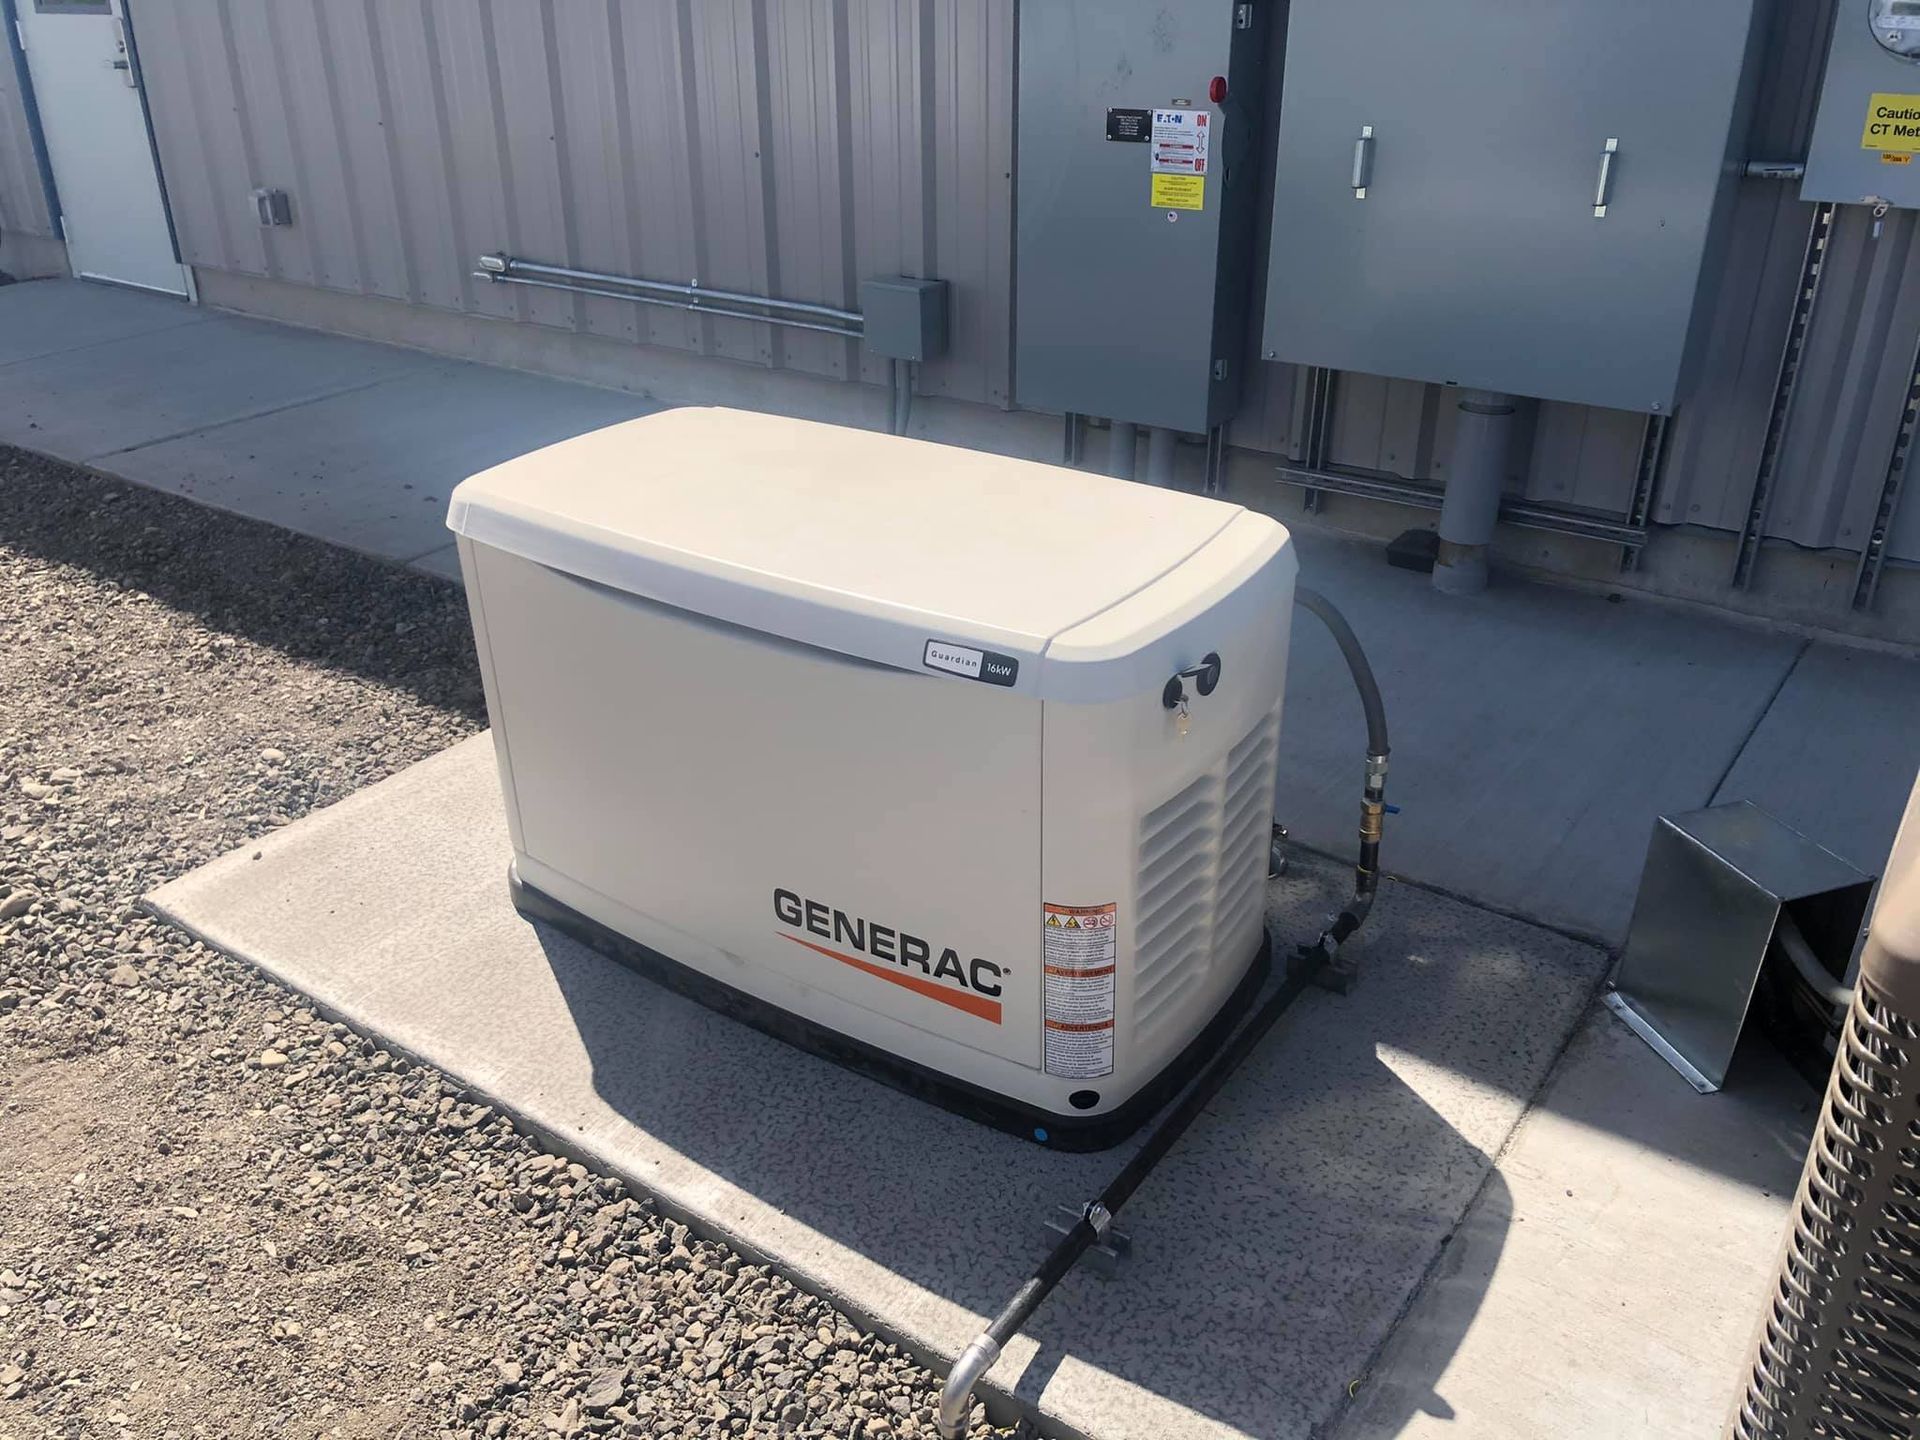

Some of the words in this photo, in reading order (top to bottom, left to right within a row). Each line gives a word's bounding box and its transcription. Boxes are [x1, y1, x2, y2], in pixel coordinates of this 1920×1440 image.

[1197, 114, 1207, 127] ON
[1870, 123, 1891, 135] CT
[931, 650, 977, 667] Guardian
[987, 662, 1012, 676] 16kW
[773, 887, 1002, 997] GENERAC
